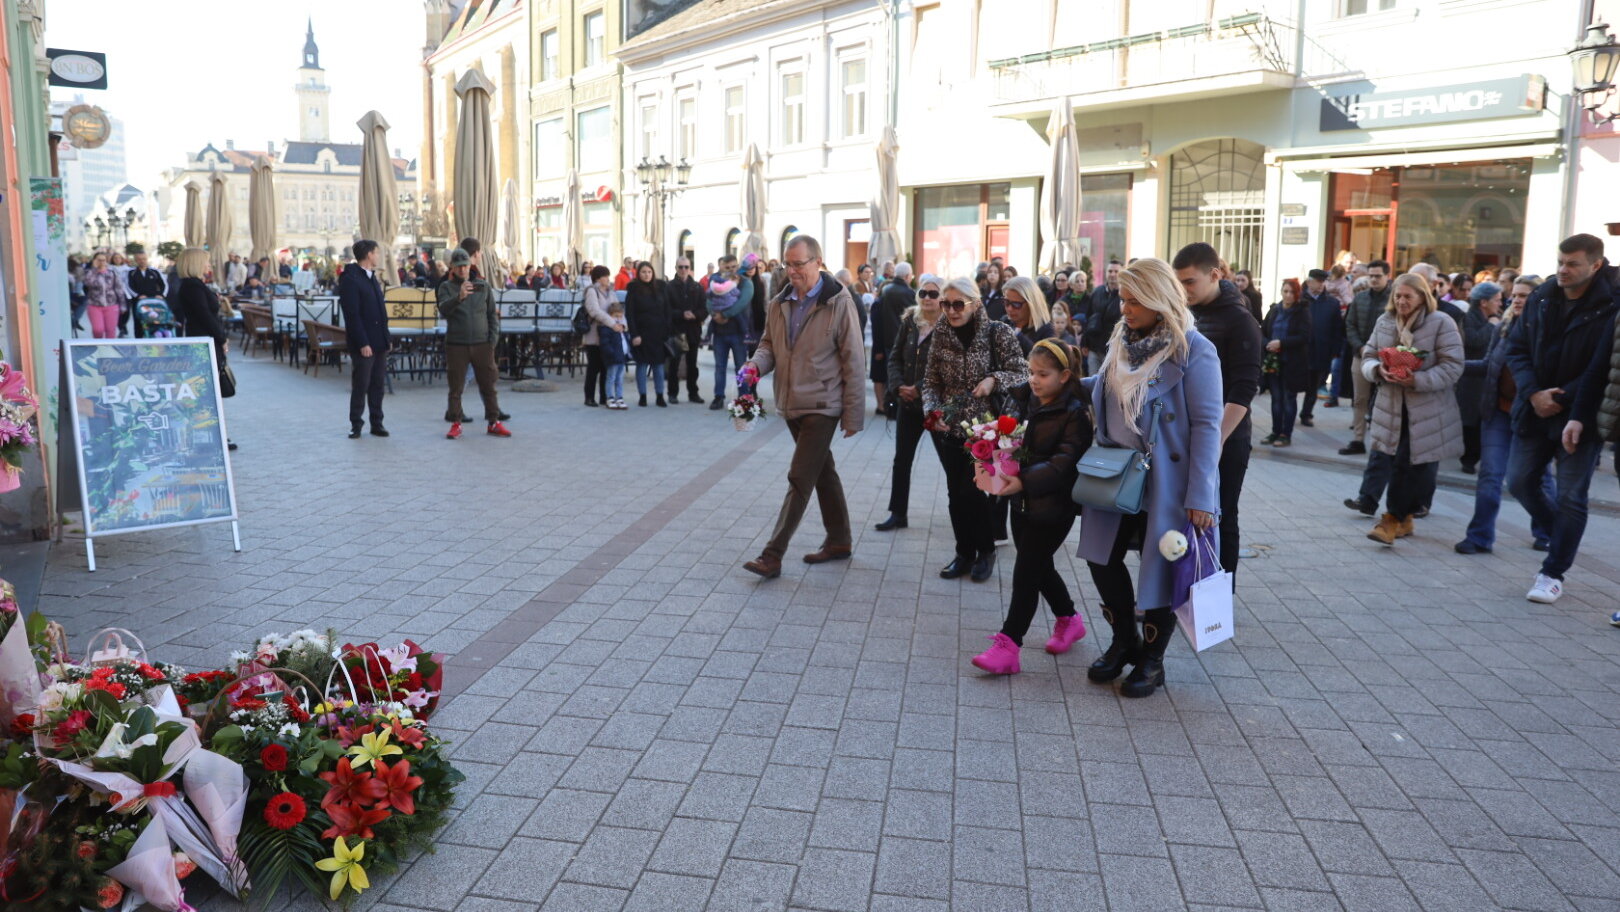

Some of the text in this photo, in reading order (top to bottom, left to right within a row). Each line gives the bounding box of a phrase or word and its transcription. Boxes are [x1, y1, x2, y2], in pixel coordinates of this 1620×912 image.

[1348, 90, 1484, 122] STEFANO
[101, 359, 193, 373] Beer Garden
[102, 379, 196, 404] BAŠTA
